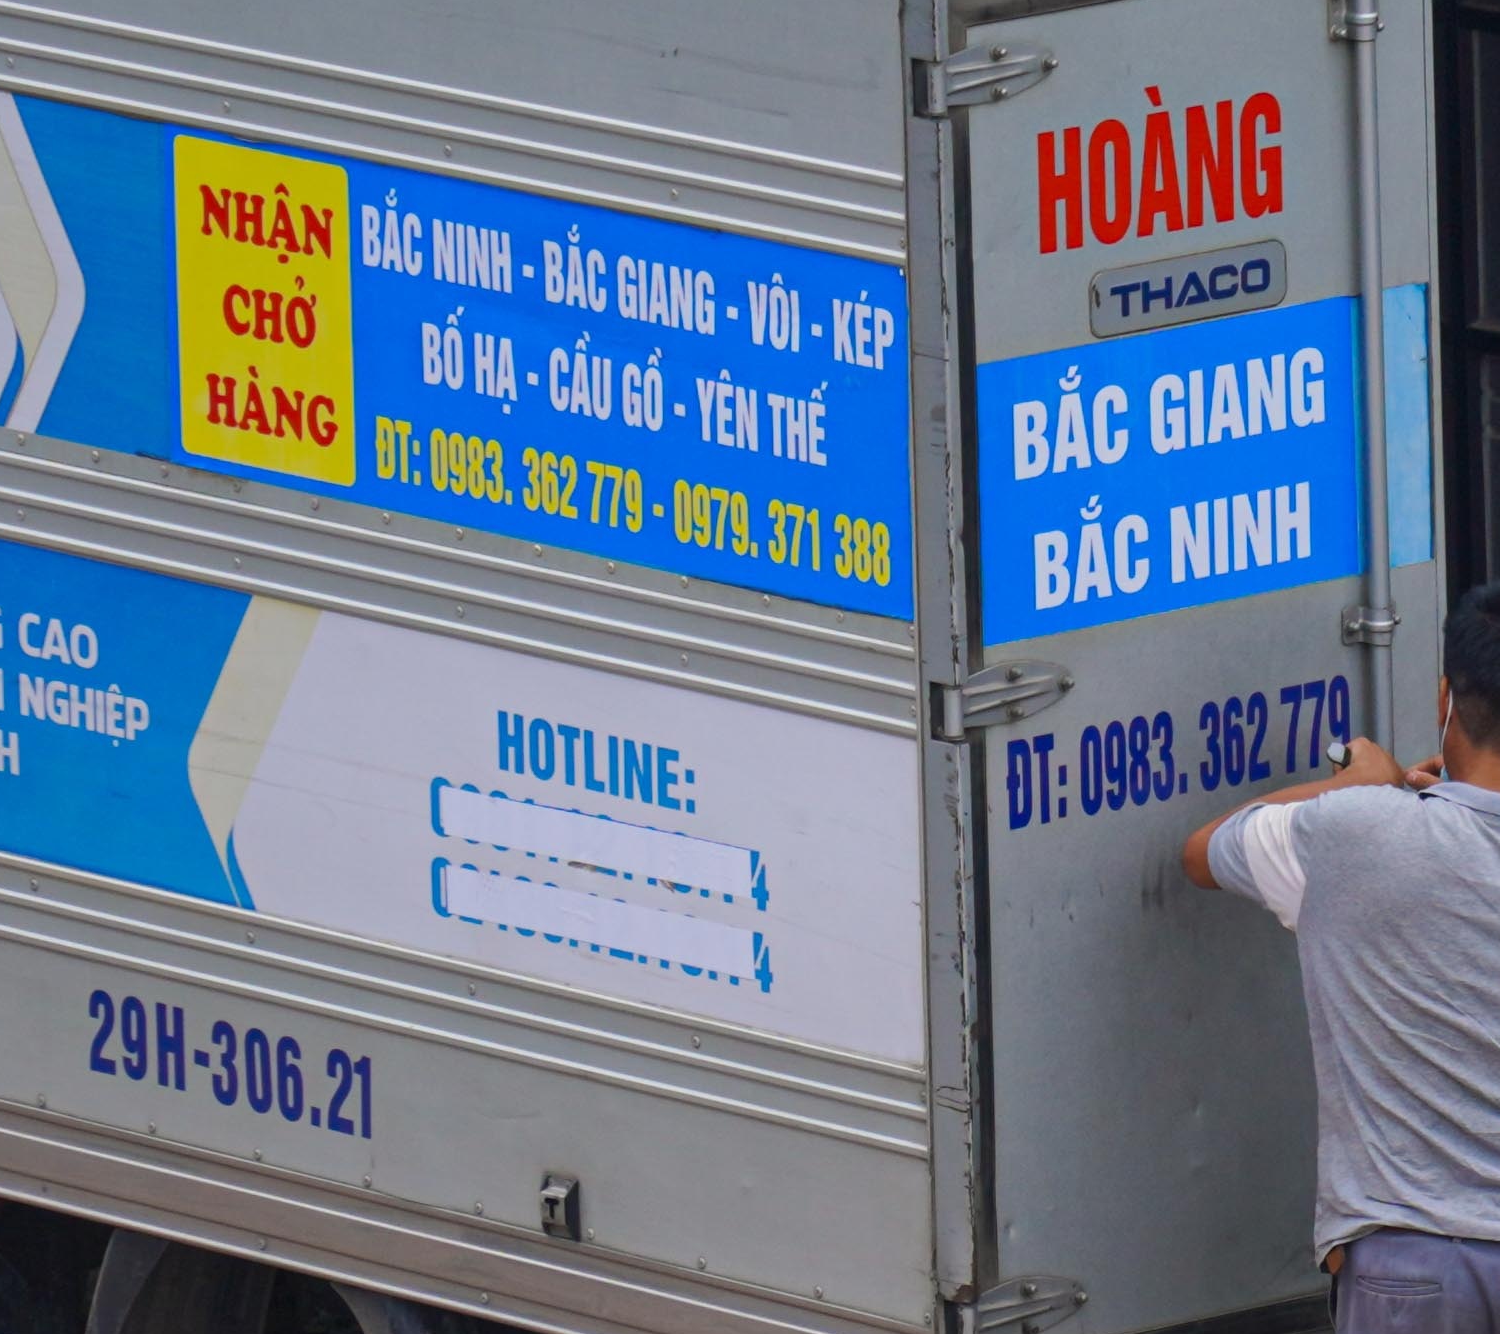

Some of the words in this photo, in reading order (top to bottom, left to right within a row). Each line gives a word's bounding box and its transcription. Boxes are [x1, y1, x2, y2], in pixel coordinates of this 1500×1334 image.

[199, 183, 334, 266] NHẬN
[1037, 85, 1284, 255] HOÀNG
[223, 276, 318, 349] CHỞ
[360, 188, 424, 278] BẮC
[432, 218, 514, 295] NINH
[542, 224, 608, 314] BẮC
[616, 254, 716, 337] GIANG
[746, 272, 801, 354] VÔI
[831, 290, 896, 372] KÉP
[1109, 257, 1271, 318] THACO
[206, 366, 339, 449] HÀNG
[421, 306, 467, 393] BỐ
[474, 337, 519, 416] HẠ
[548, 330, 612, 422] CẦU
[620, 346, 665, 433] GỒ
[695, 369, 760, 453] YÊN
[766, 381, 829, 468] THẾ
[1012, 365, 1130, 481] BẮC
[1149, 346, 1326, 455] GIANG
[374, 414, 423, 487] ĐT:
[431, 428, 514, 506] 0983.
[520, 445, 579, 520] 362
[586, 459, 644, 535] 779
[672, 479, 760, 560] 0979.
[766, 498, 821, 573] 371
[833, 514, 891, 588] 388
[1033, 496, 1151, 611] BẮC
[1169, 481, 1312, 585] NINH
[17, 611, 100, 671] CAO
[19, 671, 151, 749] NGHIỆP
[496, 708, 699, 816] HOTLINE:
[1007, 731, 1068, 831] ĐT:
[1079, 710, 1189, 818] 0983.
[1199, 691, 1273, 792] 362
[1279, 674, 1353, 775] 779
[88, 988, 373, 1141] 29H-306.21
